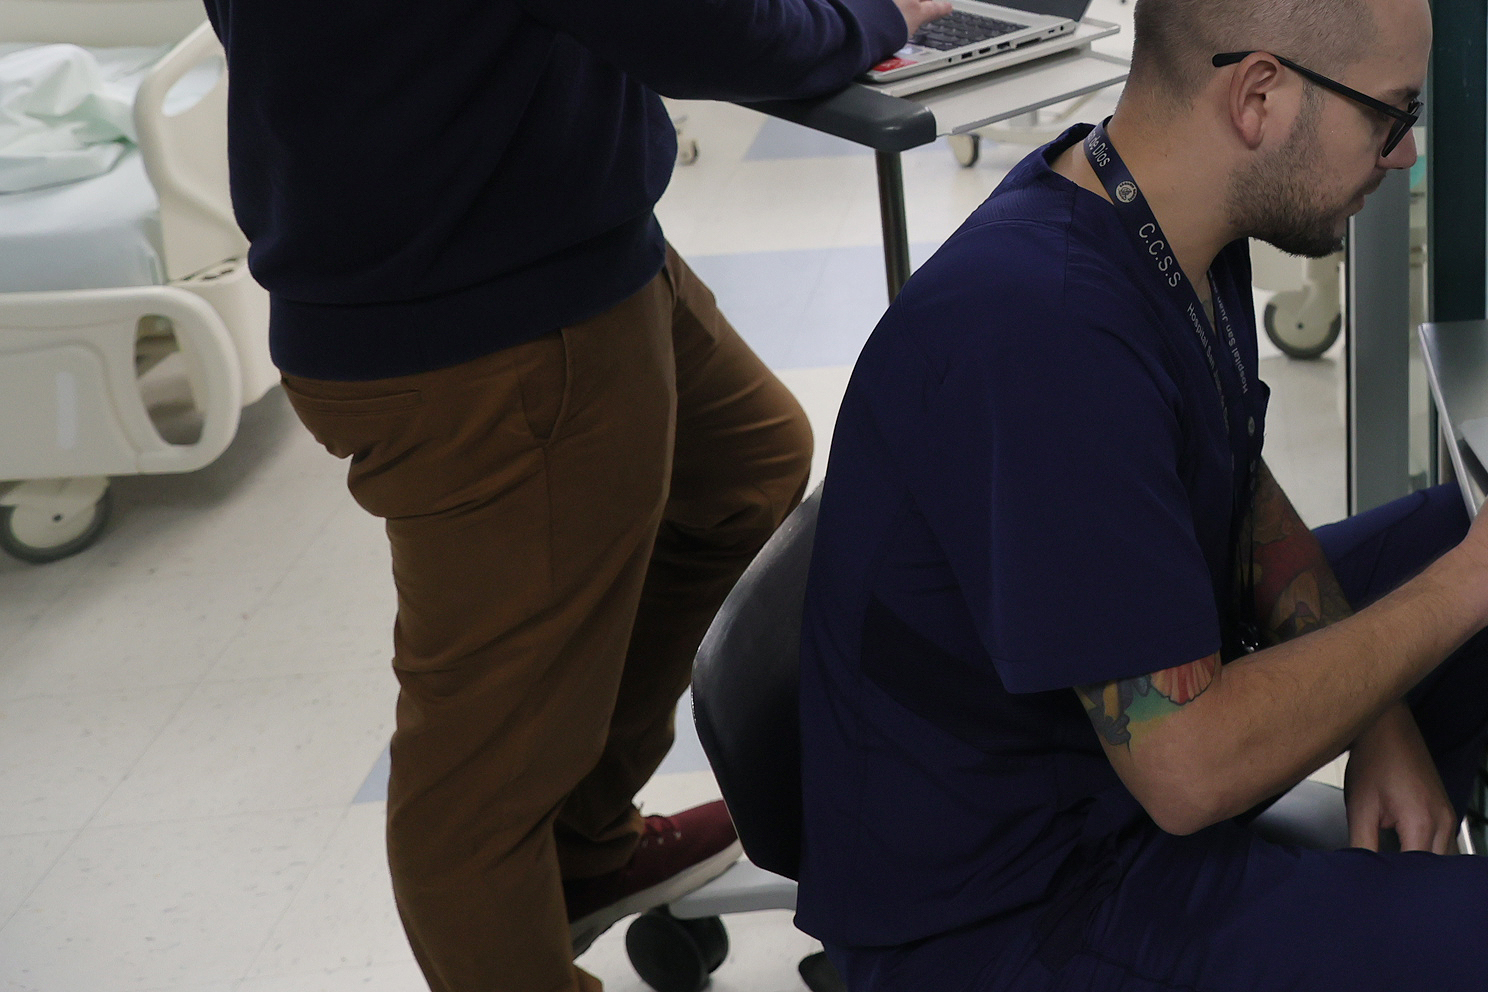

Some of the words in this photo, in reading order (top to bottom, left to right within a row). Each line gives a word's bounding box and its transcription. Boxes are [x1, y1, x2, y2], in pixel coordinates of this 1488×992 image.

[1092, 142, 1111, 168] Dios
[1186, 302, 1209, 350] Hospital
[1225, 324, 1237, 348] San
[1231, 347, 1249, 396] Hospital
